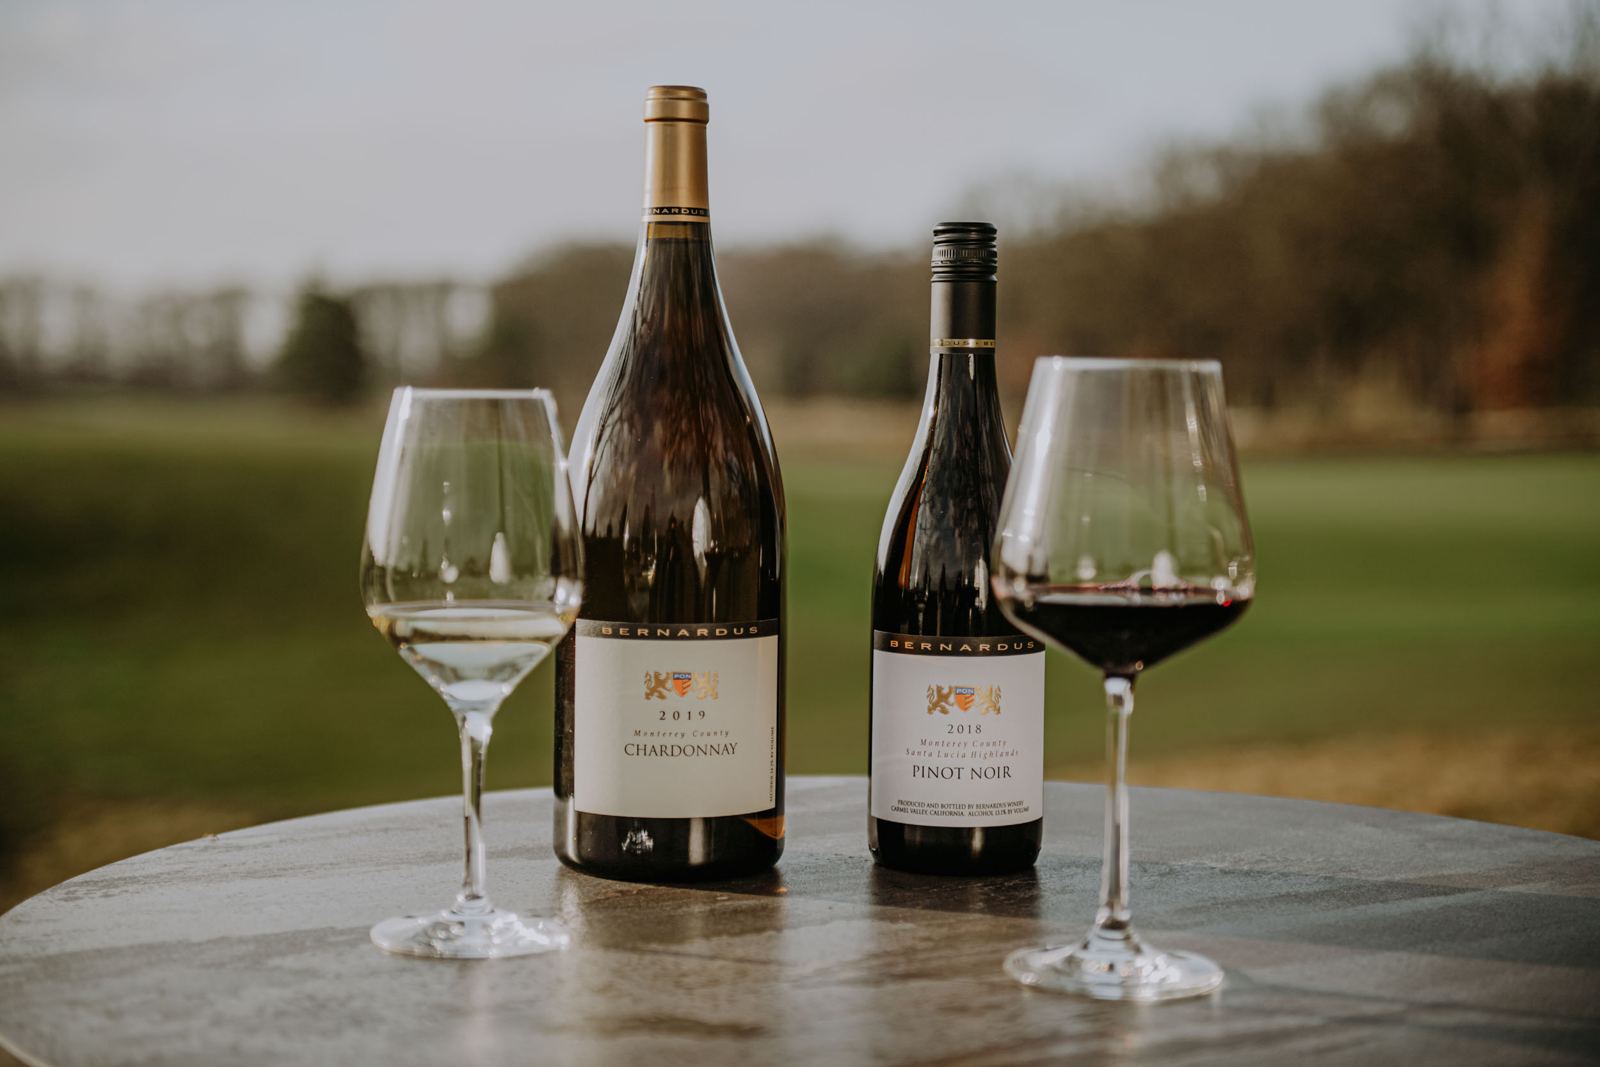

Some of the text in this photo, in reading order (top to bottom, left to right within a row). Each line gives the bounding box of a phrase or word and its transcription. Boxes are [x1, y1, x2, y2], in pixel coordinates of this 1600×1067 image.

[601, 626, 758, 637] BERNARDUS
[890, 640, 1035, 651] BERNARDUS
[659, 710, 706, 721] 2019
[633, 729, 730, 739] Monterey County
[947, 724, 982, 734] 2018
[624, 742, 738, 757] CHARDONNAY
[920, 739, 1007, 749] Monterey County
[905, 748, 933, 758] Santa
[971, 749, 1019, 760] Highlands
[912, 764, 1012, 780] PINOT NOIR
[891, 805, 908, 813] CARMEL
[897, 800, 925, 808] PRODUCED
[975, 801, 1006, 810] BERNARDUS
